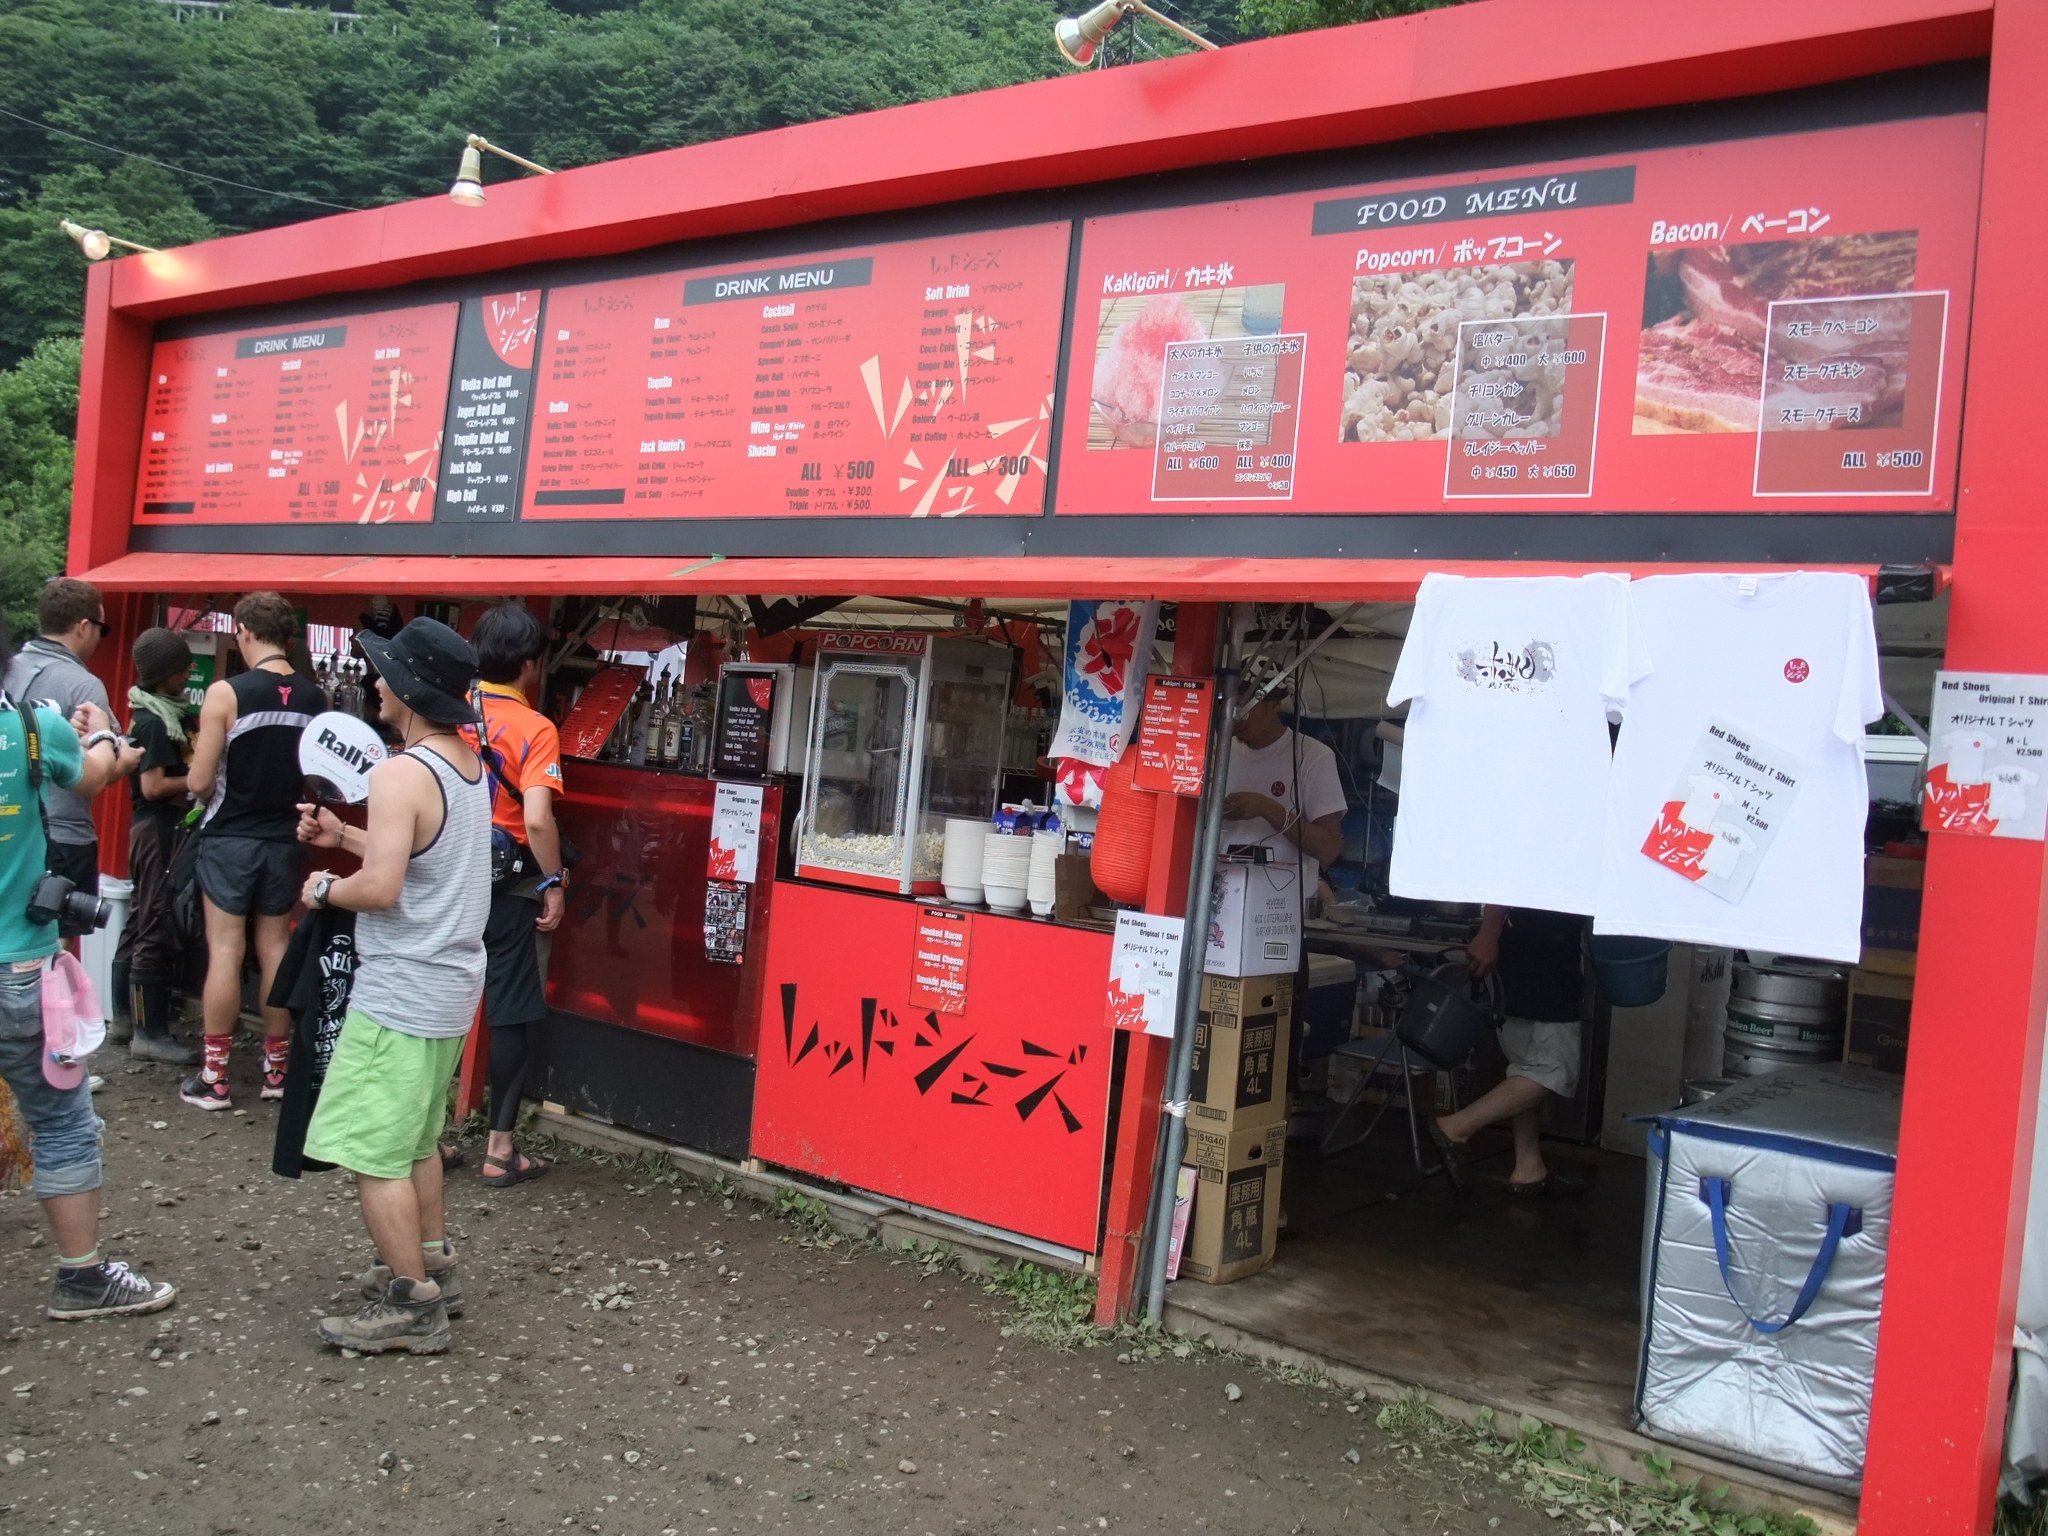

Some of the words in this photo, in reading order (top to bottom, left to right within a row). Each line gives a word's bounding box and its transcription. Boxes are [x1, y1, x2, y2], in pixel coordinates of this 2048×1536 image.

[1357, 196, 1447, 225] FOOD
[1466, 178, 1578, 215] MENU
[1740, 206, 1831, 234] ベーコン
[1453, 231, 1563, 263] ポップコーン
[715, 277, 771, 298] DRINK
[779, 269, 834, 290] MENU
[1185, 262, 1235, 287] カキ氷
[925, 287, 943, 301] Soft
[946, 284, 970, 299] Drink
[763, 303, 795, 319] Cocktail
[1787, 319, 1878, 338] スモークベーコン
[254, 338, 287, 354] DRINK
[292, 333, 325, 348] MENU
[1473, 333, 1514, 348] 塩バター
[1170, 346, 1223, 361] 大人のカキ氷
[1243, 340, 1300, 356] 子供のカキ氷
[1481, 356, 1491, 369] 中
[1537, 353, 1549, 365] 大
[1783, 363, 1865, 380] スモークチキン
[647, 376, 673, 390] Tequila
[751, 421, 771, 434] Wine
[1466, 412, 1531, 427] グリーンカレー
[640, 440, 656, 453] Jack
[747, 444, 777, 458] Shochu
[1463, 441, 1547, 456] クレイジーペッパー
[946, 458, 970, 477] ALL
[1166, 457, 1183, 470] ALL
[1236, 455, 1253, 469] ALL
[1842, 451, 1866, 468] ALL
[1877, 450, 1923, 467] ¥500
[801, 463, 822, 481] ALL
[833, 460, 875, 480] ¥500
[1471, 466, 1482, 479] 中
[1528, 465, 1539, 478] 大
[823, 633, 923, 652] POPCORN
[1942, 681, 1959, 691] Red
[1962, 681, 1991, 692] Shoes
[1978, 694, 2015, 705] Original
[2019, 696, 2025, 705] T
[29, 733, 39, 760] Nikon
[1709, 725, 1725, 739] Red
[1726, 733, 1751, 752] Shoes
[317, 728, 375, 775] Rally
[1735, 751, 1767, 773] Original
[1768, 768, 1775, 776] T
[1774, 771, 1796, 788] Shirt
[1120, 917, 1130, 925] Red
[1131, 919, 1146, 927] Shoes
[920, 926, 943, 938] Smoked
[944, 930, 963, 941] Bacon
[918, 950, 941, 962] Smoked
[942, 954, 964, 966] Cheese
[916, 974, 939, 987] Smoked
[941, 979, 964, 991] Chicken
[1212, 979, 1239, 991] S1G40
[1749, 1023, 1773, 1036] Beer
[1244, 1029, 1272, 1049] 業務用
[780, 983, 1088, 1135] レッドシューズ
[1244, 1053, 1269, 1076] 角瓶
[1246, 1076, 1262, 1095] 4L
[1200, 1133, 1224, 1146] S1G40
[1231, 1181, 1260, 1203] 業務用
[1231, 1205, 1258, 1230] 角瓶
[1236, 1230, 1252, 1249] 4L
